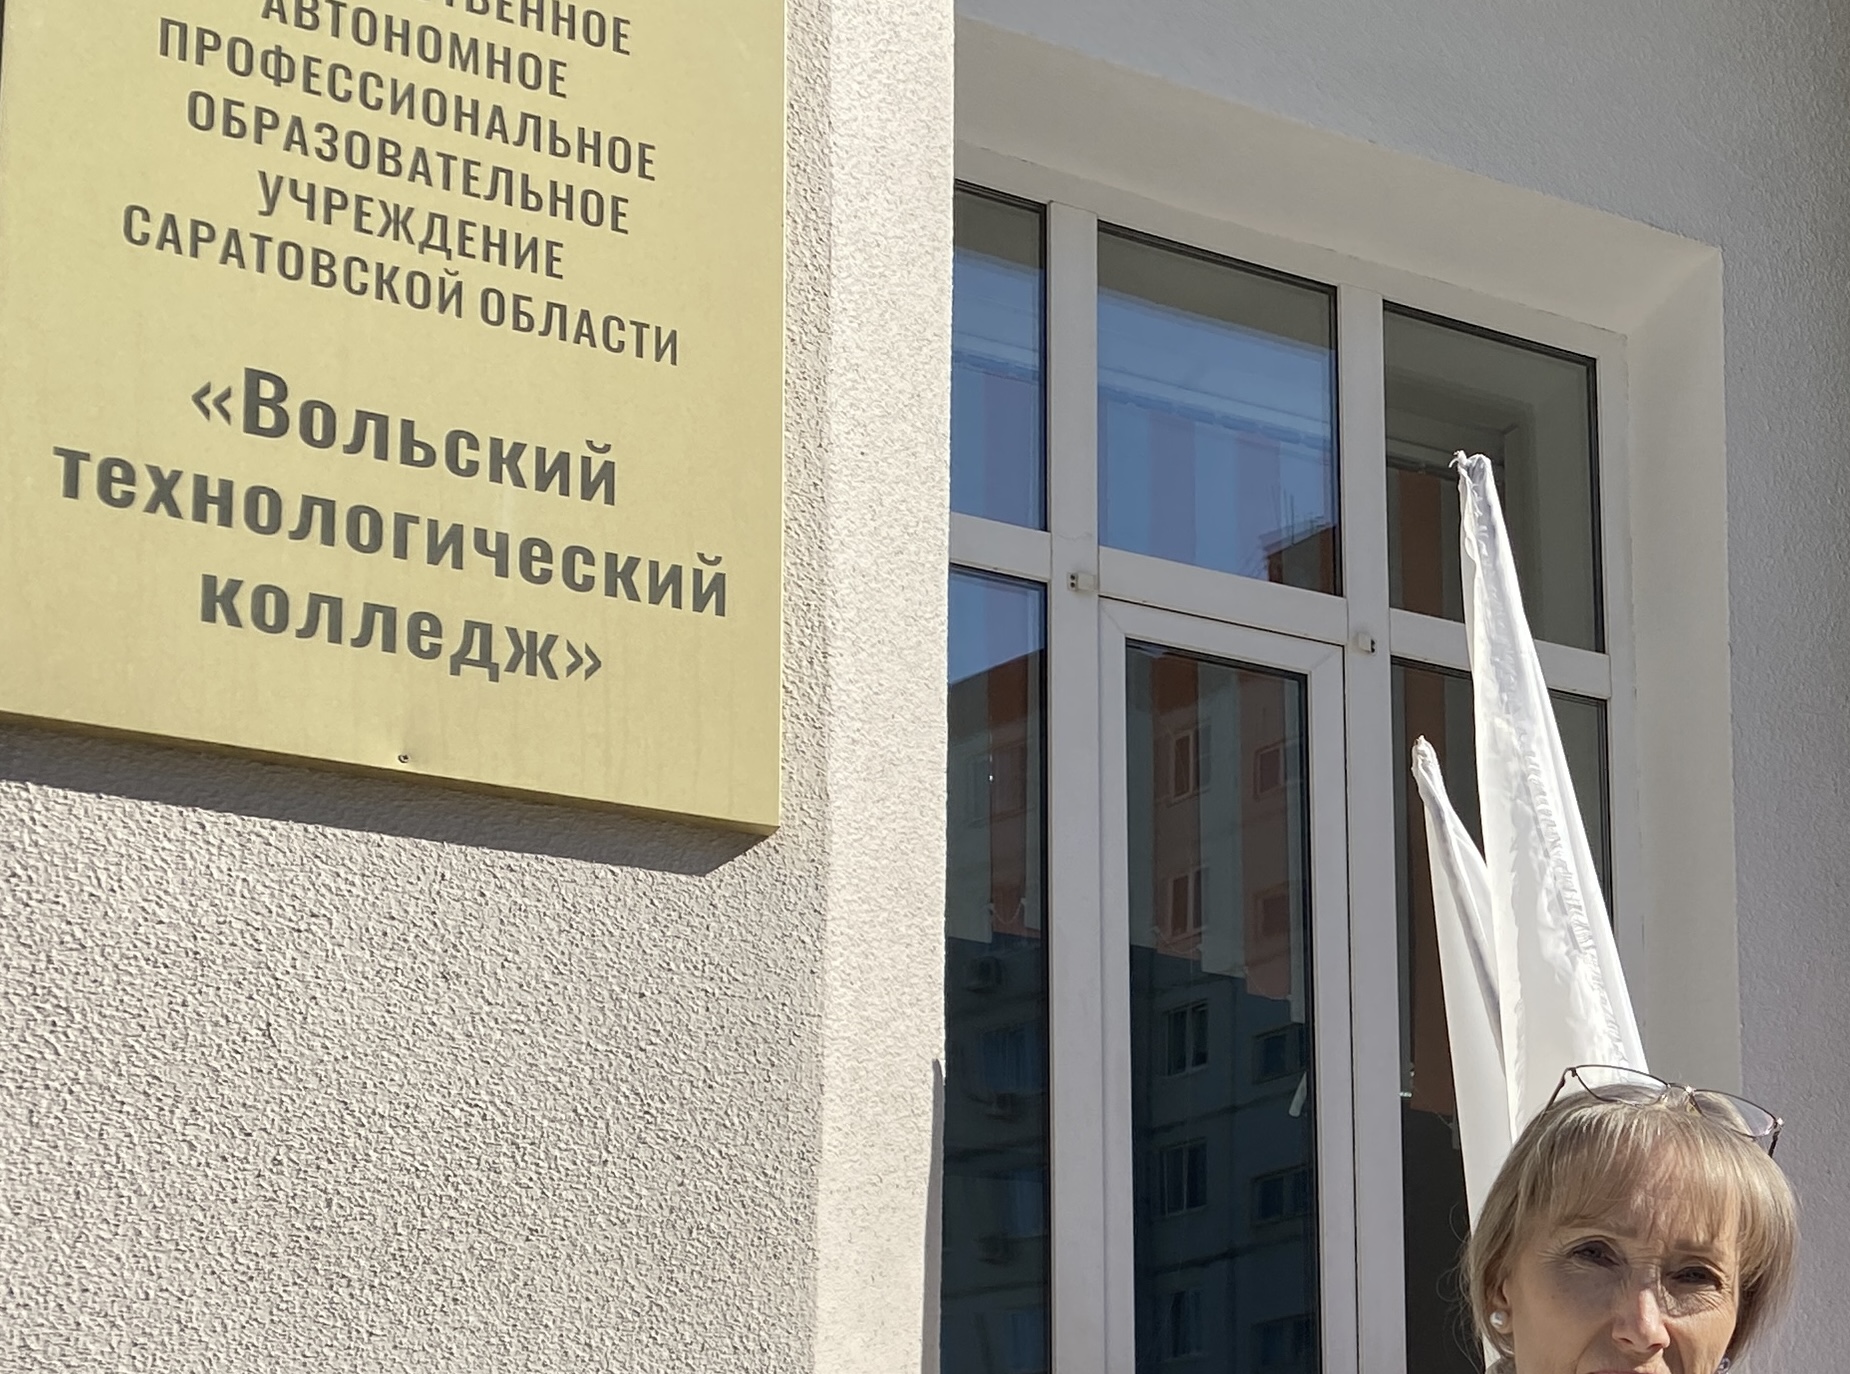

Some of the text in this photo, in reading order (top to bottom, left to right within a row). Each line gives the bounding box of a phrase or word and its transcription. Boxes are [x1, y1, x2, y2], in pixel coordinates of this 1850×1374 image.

[159, 17, 657, 182] ПРОФЕССИОНАЛЬНОЕ
[261, 0, 568, 99] АВТОНОМНОЕ
[187, 89, 630, 235] ОБРАЗОВАТЕЛЬНОЕ
[256, 169, 565, 281] УЧРЕЖДЕНИЕ
[122, 203, 680, 366] САРАТОВСКОЙ ОБЛАСТИ
[190, 366, 618, 506] «Вольский
[52, 445, 728, 617] технологический
[199, 573, 602, 683] колледж»
